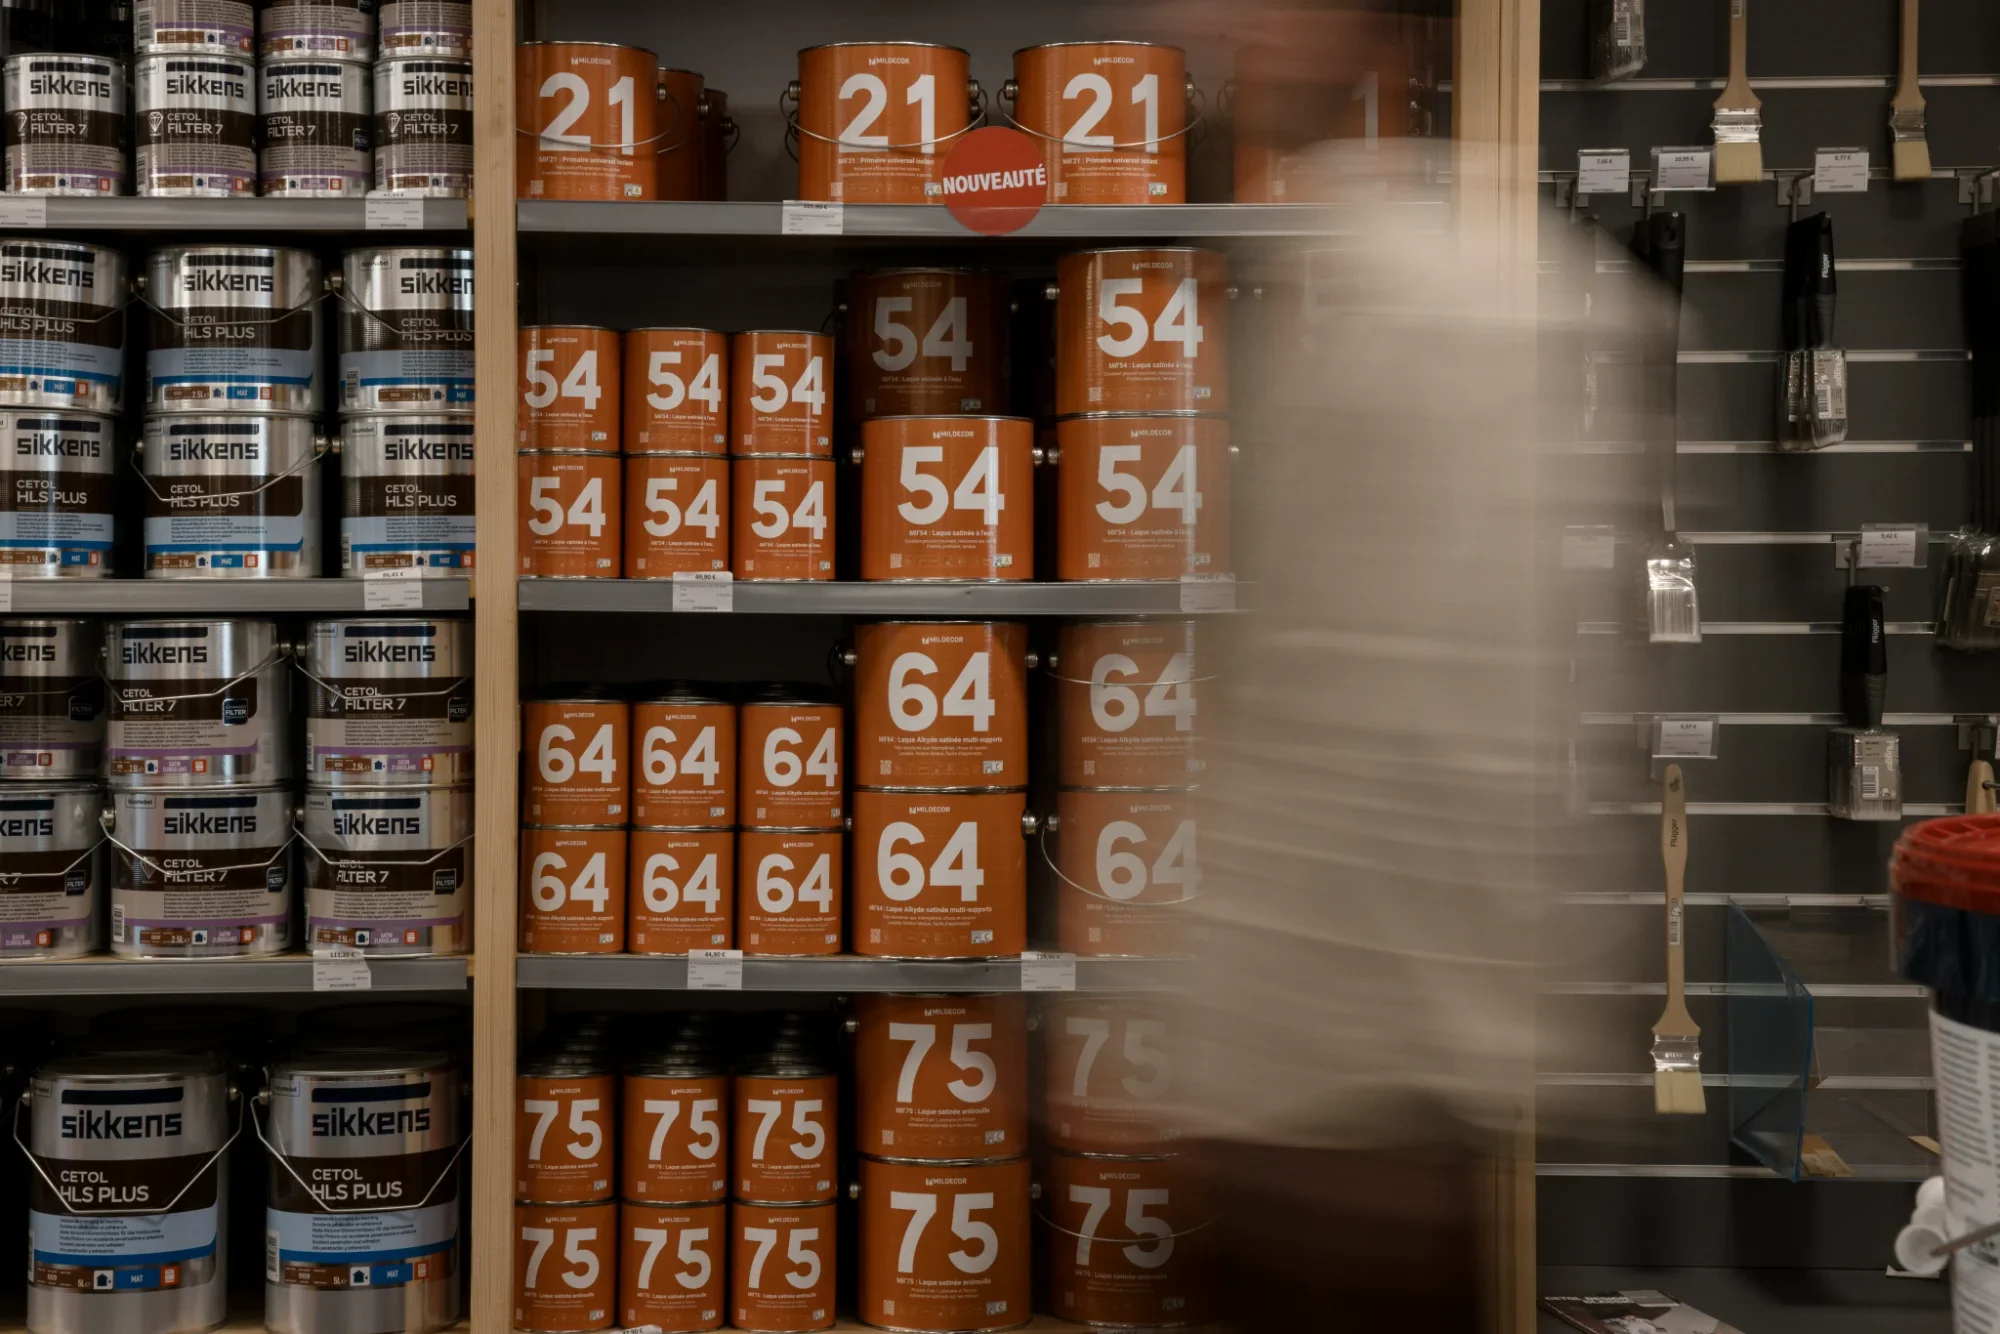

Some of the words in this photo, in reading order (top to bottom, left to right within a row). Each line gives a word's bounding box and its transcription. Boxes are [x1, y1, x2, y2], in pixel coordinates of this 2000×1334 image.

[30, 75, 110, 98] sikkens
[167, 74, 244, 98] sikkens
[267, 78, 341, 99] sikkens
[403, 76, 473, 97] sikken
[30, 112, 64, 121] CETOL
[167, 112, 201, 121] CETOL
[267, 116, 294, 125] CETOL
[403, 113, 437, 122] CETOL
[539, 72, 635, 155] 21
[838, 73, 935, 154] 21
[1062, 73, 1158, 153] 21
[30, 122, 75, 135] FILTER
[78, 123, 87, 135] 7
[167, 122, 212, 135] FILTER
[215, 124, 224, 135] 7
[267, 125, 305, 137] FILTER
[307, 125, 316, 136] 7
[403, 123, 447, 134] FILTER
[450, 124, 459, 134] 7
[943, 165, 1047, 194] NOUVEAUTÉ
[1, 260, 94, 288] sikkens
[183, 269, 273, 292] sikkens
[401, 272, 474, 294] sikken
[0, 317, 31, 331] HLS
[35, 318, 75, 333] PLUS
[401, 318, 440, 327] CETOL
[1096, 278, 1203, 358] 54
[183, 327, 212, 339] HLS
[215, 326, 255, 339] PLUS
[436, 329, 473, 342] PLUS
[872, 297, 973, 371] 54
[1132, 362, 1151, 370] Laque
[524, 349, 601, 410] 54
[646, 351, 721, 412] 54
[750, 354, 825, 415] 54
[17, 434, 100, 457] sikkens
[170, 438, 259, 460] sikkens
[385, 438, 474, 460] sikkens
[17, 480, 56, 489] CETOL
[170, 484, 204, 494] CETOL
[385, 484, 422, 493] CETOL
[897, 446, 1004, 525] 54
[1096, 445, 1203, 524] 54
[17, 491, 48, 503] HLS
[52, 492, 87, 504] PLUS
[170, 496, 197, 508] HLS
[201, 495, 240, 508] PLUS
[385, 495, 415, 507] HLS
[420, 495, 457, 507] PLUS
[528, 476, 605, 537] 54
[643, 478, 719, 538] 54
[751, 480, 826, 539] 54
[695, 573, 709, 581] 49,90
[122, 642, 207, 664] sikkens
[345, 641, 436, 662] sikkens
[123, 688, 152, 698] CETOL
[345, 687, 381, 696] CETOL
[888, 651, 995, 732] 64
[1090, 653, 1197, 732] 64
[123, 701, 164, 712] FILTER
[168, 700, 176, 711] 7
[345, 698, 392, 711] FILTER
[396, 698, 407, 711] 7
[917, 736, 937, 744] Alkyde
[538, 723, 616, 783] 64
[642, 726, 719, 786] 64
[763, 727, 838, 787] 64
[164, 812, 256, 834] sikkens
[333, 813, 420, 835] sikkens
[1669, 818, 1678, 848] Flügger
[164, 858, 202, 868] CETOL
[877, 821, 984, 901] 64
[1096, 820, 1203, 900] 64
[164, 870, 214, 882] FILTER
[218, 870, 228, 882] 7
[336, 870, 376, 883] FILTER
[380, 870, 390, 883] 7
[436, 879, 455, 887] FILTER
[531, 852, 609, 912] 64
[643, 853, 720, 913] 64
[757, 853, 833, 913] 64
[904, 906, 924, 914] Alkyde
[889, 1022, 997, 1103] 75
[1066, 1016, 1171, 1098] 75
[62, 1110, 182, 1139] sikkens
[312, 1107, 430, 1136] sikkens
[524, 1098, 602, 1160] 75
[644, 1099, 720, 1160] 75
[748, 1099, 825, 1160] 75
[61, 1170, 108, 1183] CETOL
[312, 1168, 363, 1181] CETOL
[60, 1186, 94, 1202] HLS
[99, 1186, 149, 1202] PLUS
[312, 1184, 348, 1200] HLS
[353, 1181, 402, 1198] PLUS
[891, 1191, 999, 1274] 75
[1069, 1184, 1175, 1268] 75
[522, 1227, 600, 1289] 75
[634, 1227, 711, 1289] 75
[744, 1226, 821, 1289] 75
[387, 1270, 399, 1278] MAT
[919, 1278, 937, 1286] Laque
